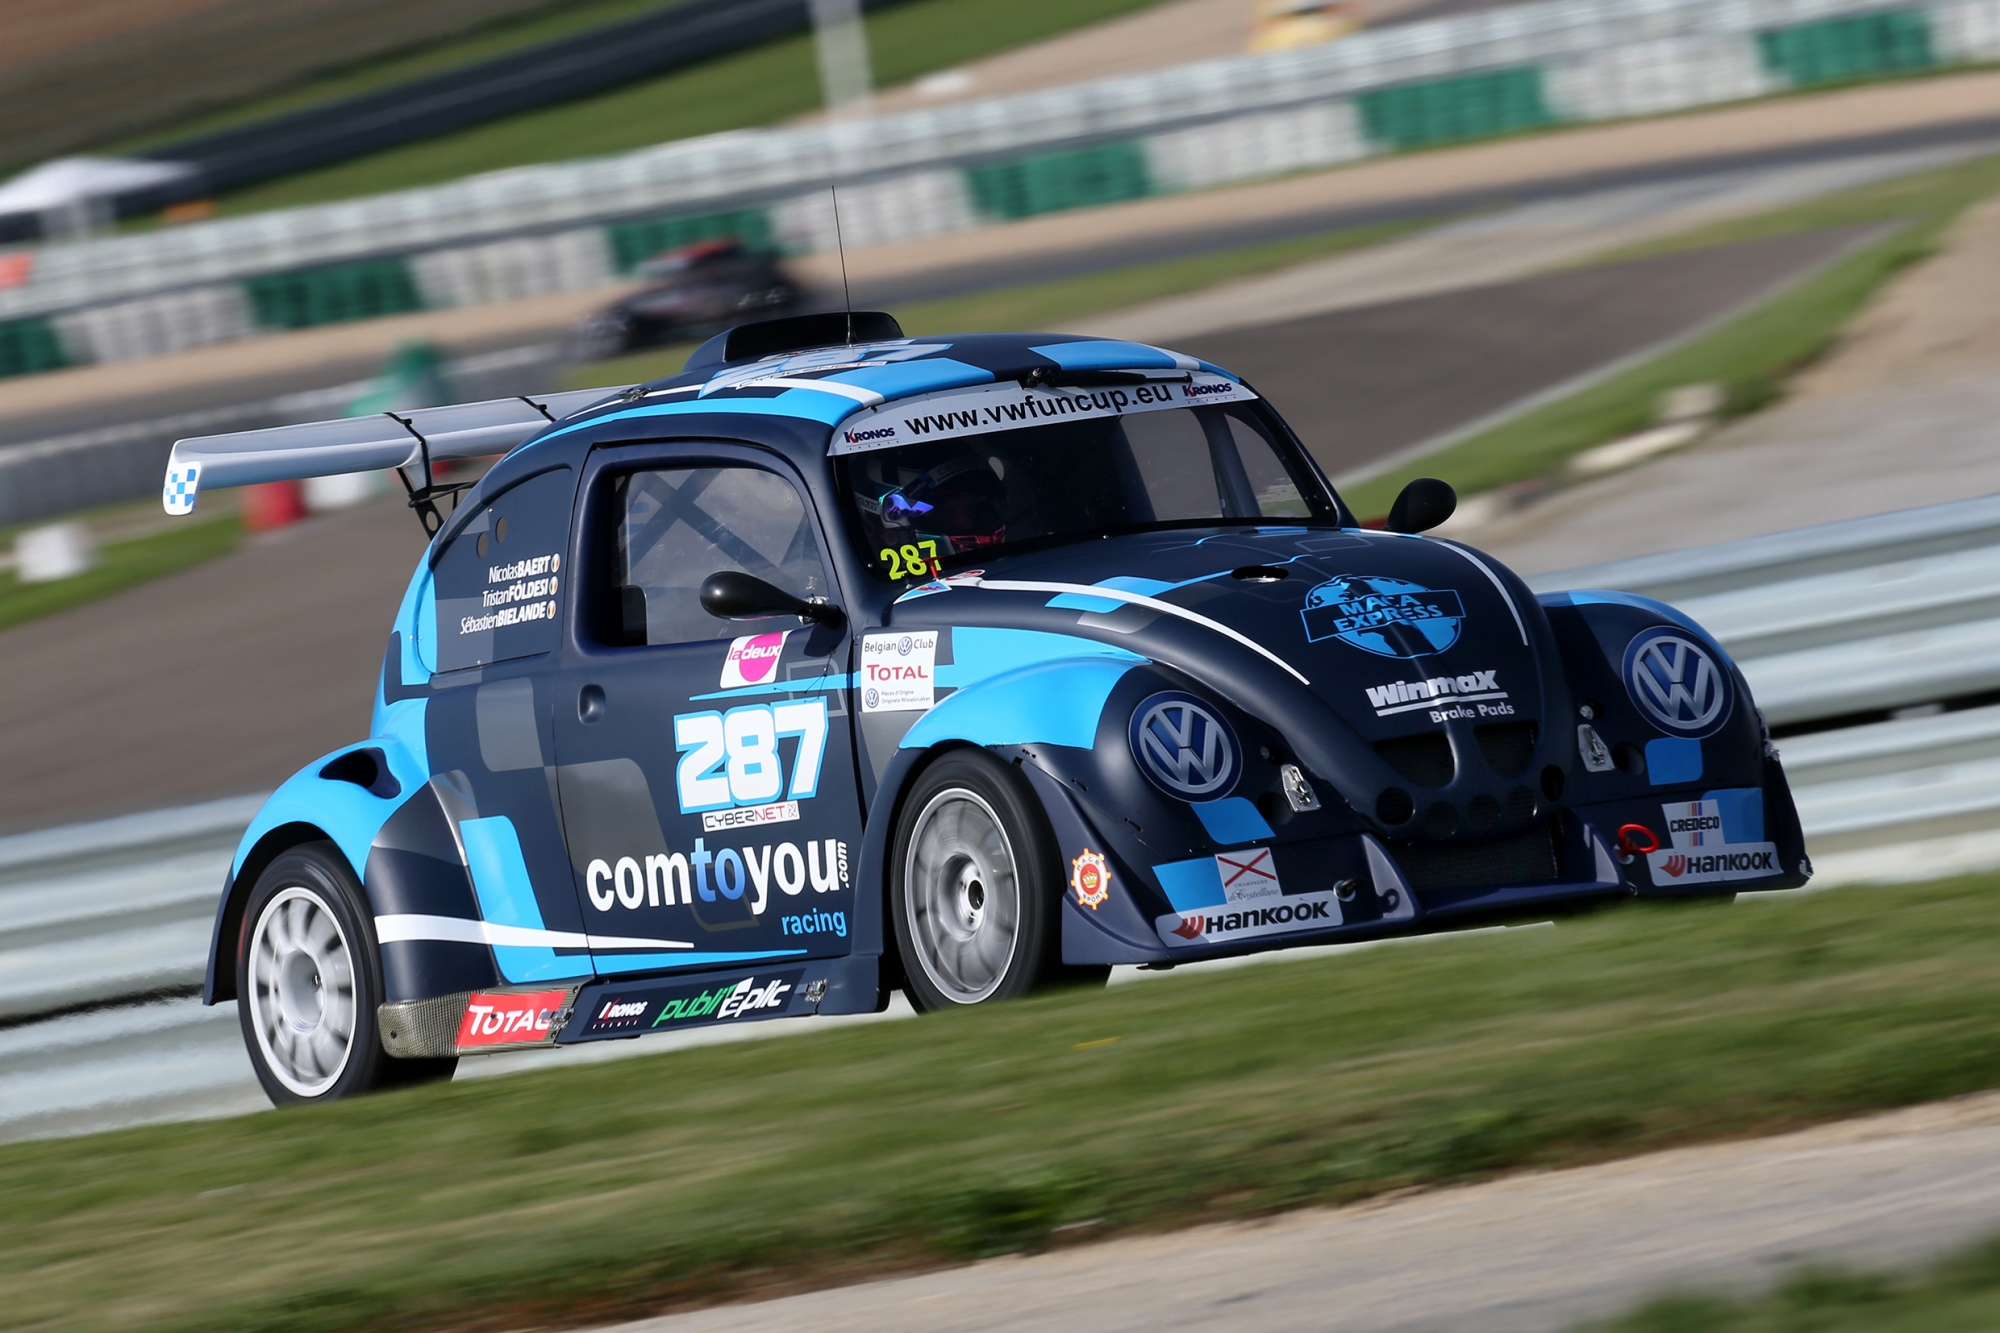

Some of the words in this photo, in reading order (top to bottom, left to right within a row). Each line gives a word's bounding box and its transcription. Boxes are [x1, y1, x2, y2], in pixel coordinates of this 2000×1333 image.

[1182, 382, 1233, 397] KRONOS
[904, 384, 1174, 435] www.vwfuncup.eu
[844, 427, 896, 443] KRONOS
[880, 540, 942, 580] 287
[1333, 605, 1444, 632] EXPRESS
[864, 640, 897, 655] Belgian
[913, 639, 934, 650] Club
[1429, 705, 1475, 723] Brake
[1479, 702, 1515, 717] Pads
[674, 697, 829, 813] 287
[1670, 816, 1720, 833] CREDECO
[586, 838, 840, 915] comtoyou
[1234, 879, 1268, 888] CHAMPAGNE
[782, 908, 847, 938] racing
